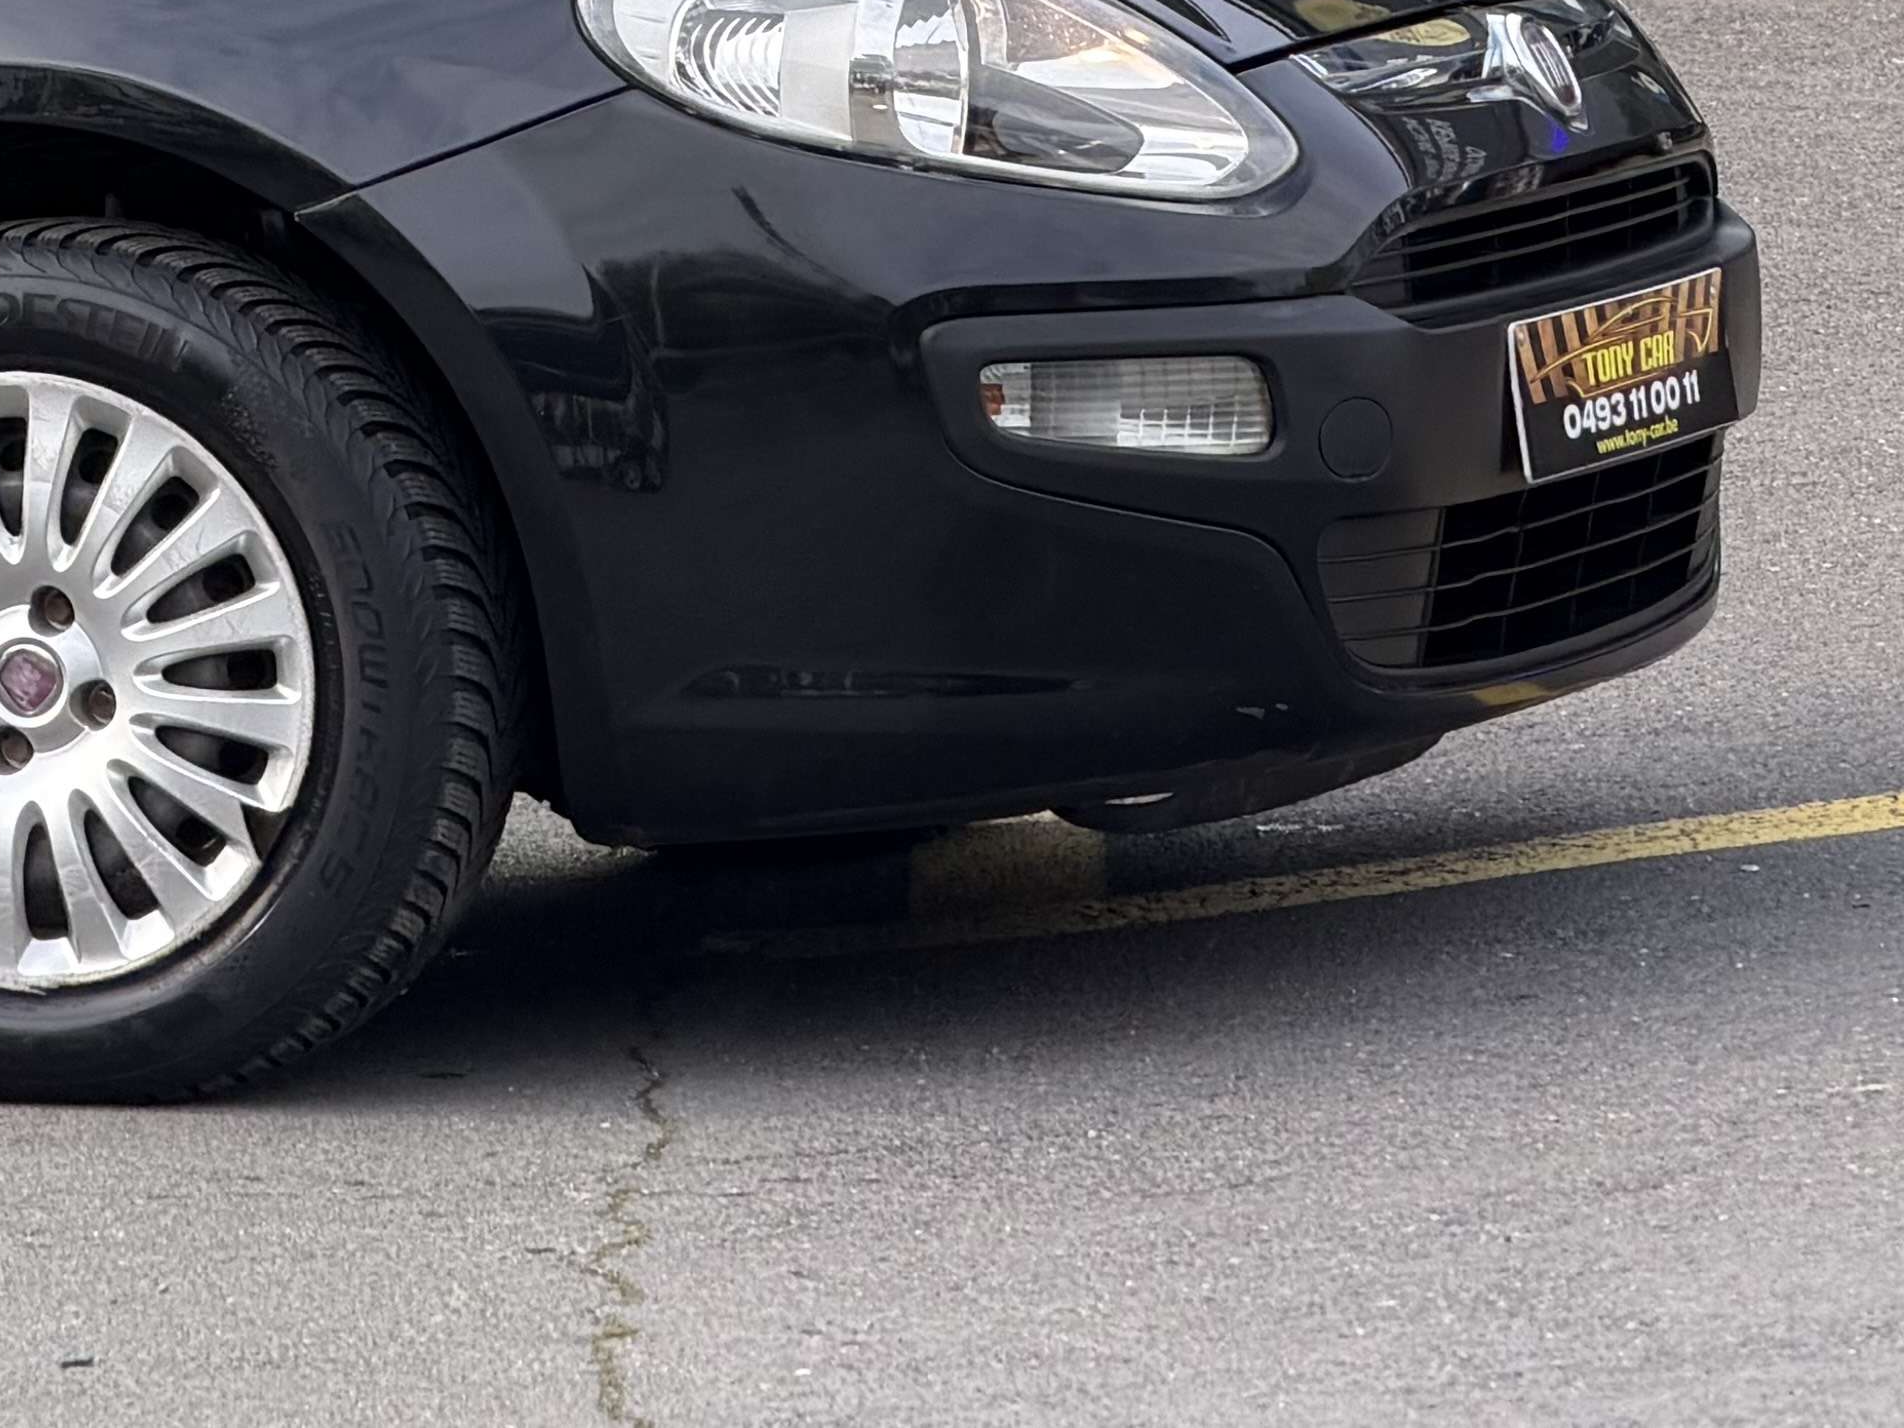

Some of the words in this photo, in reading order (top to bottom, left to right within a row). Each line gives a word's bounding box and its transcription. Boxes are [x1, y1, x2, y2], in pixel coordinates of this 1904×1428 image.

[1581, 340, 1635, 387] TONY
[1639, 329, 1676, 372] CAR
[1562, 391, 1628, 440] 0493
[1629, 387, 1649, 422] 11
[1650, 375, 1681, 416] 00
[1682, 369, 1701, 406] 11
[1595, 414, 1681, 455] www.tony-car.be
